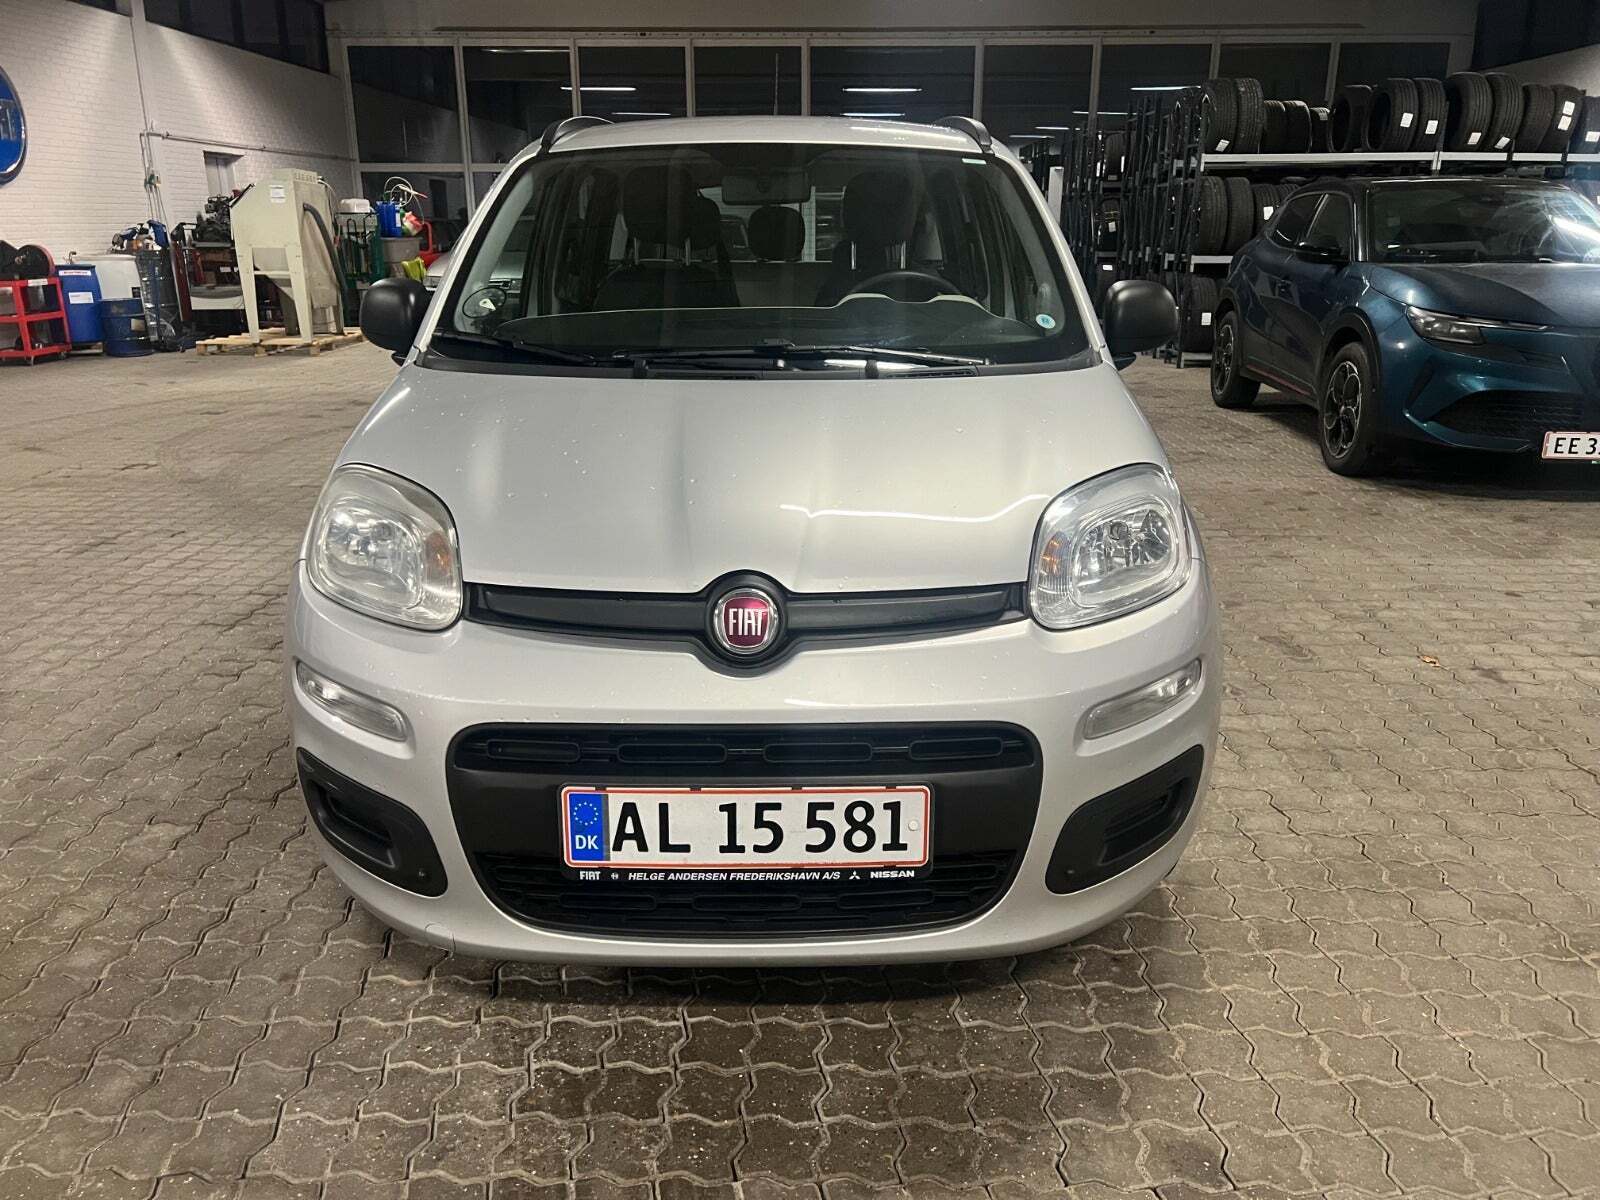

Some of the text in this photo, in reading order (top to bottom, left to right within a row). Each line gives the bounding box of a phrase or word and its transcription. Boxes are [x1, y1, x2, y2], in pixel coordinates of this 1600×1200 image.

[1553, 437, 1600, 455] EE 3
[728, 607, 768, 636] FIAT
[612, 800, 908, 854] AL 15 581
[575, 834, 599, 850] DK
[579, 870, 915, 881] FIAT HELGE ANDERSEN FREDERIKSHAVN A/S NISSAN
